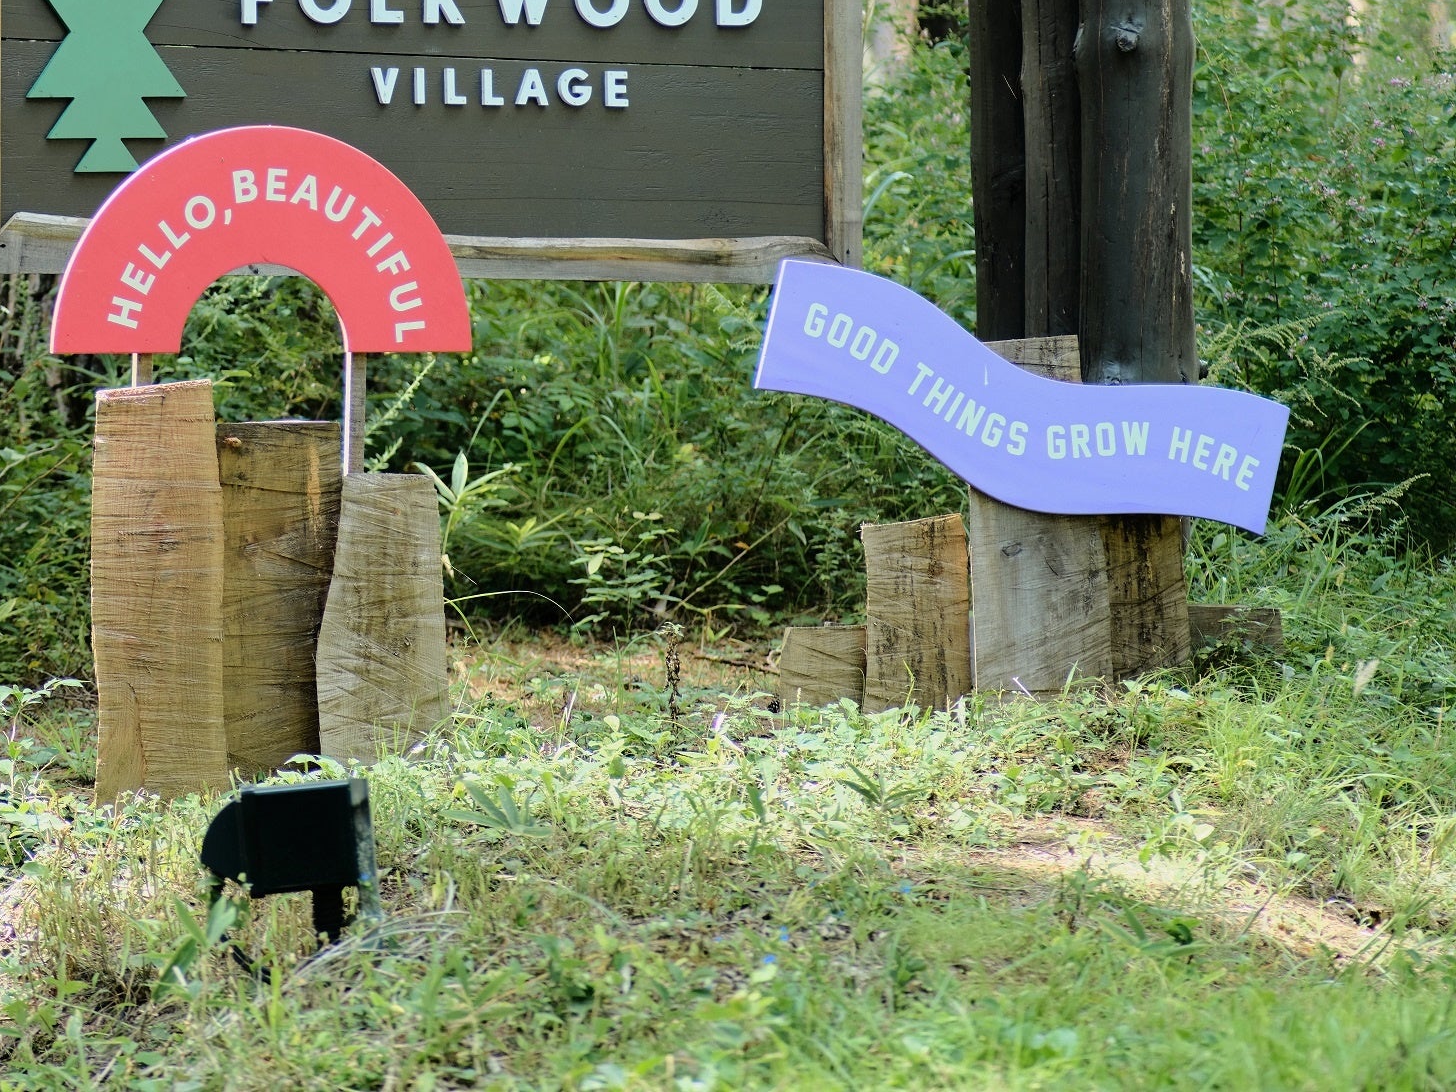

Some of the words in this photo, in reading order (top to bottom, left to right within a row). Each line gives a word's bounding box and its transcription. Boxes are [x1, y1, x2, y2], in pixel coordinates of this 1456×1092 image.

[370, 67, 630, 108] VILLAGE
[107, 194, 232, 330] HELLO,
[232, 167, 426, 343] BEAUTIFUL
[803, 301, 900, 375] GOOD
[907, 361, 1029, 456] THINGS
[1046, 421, 1149, 460] GROW
[1168, 426, 1261, 492] HERE
